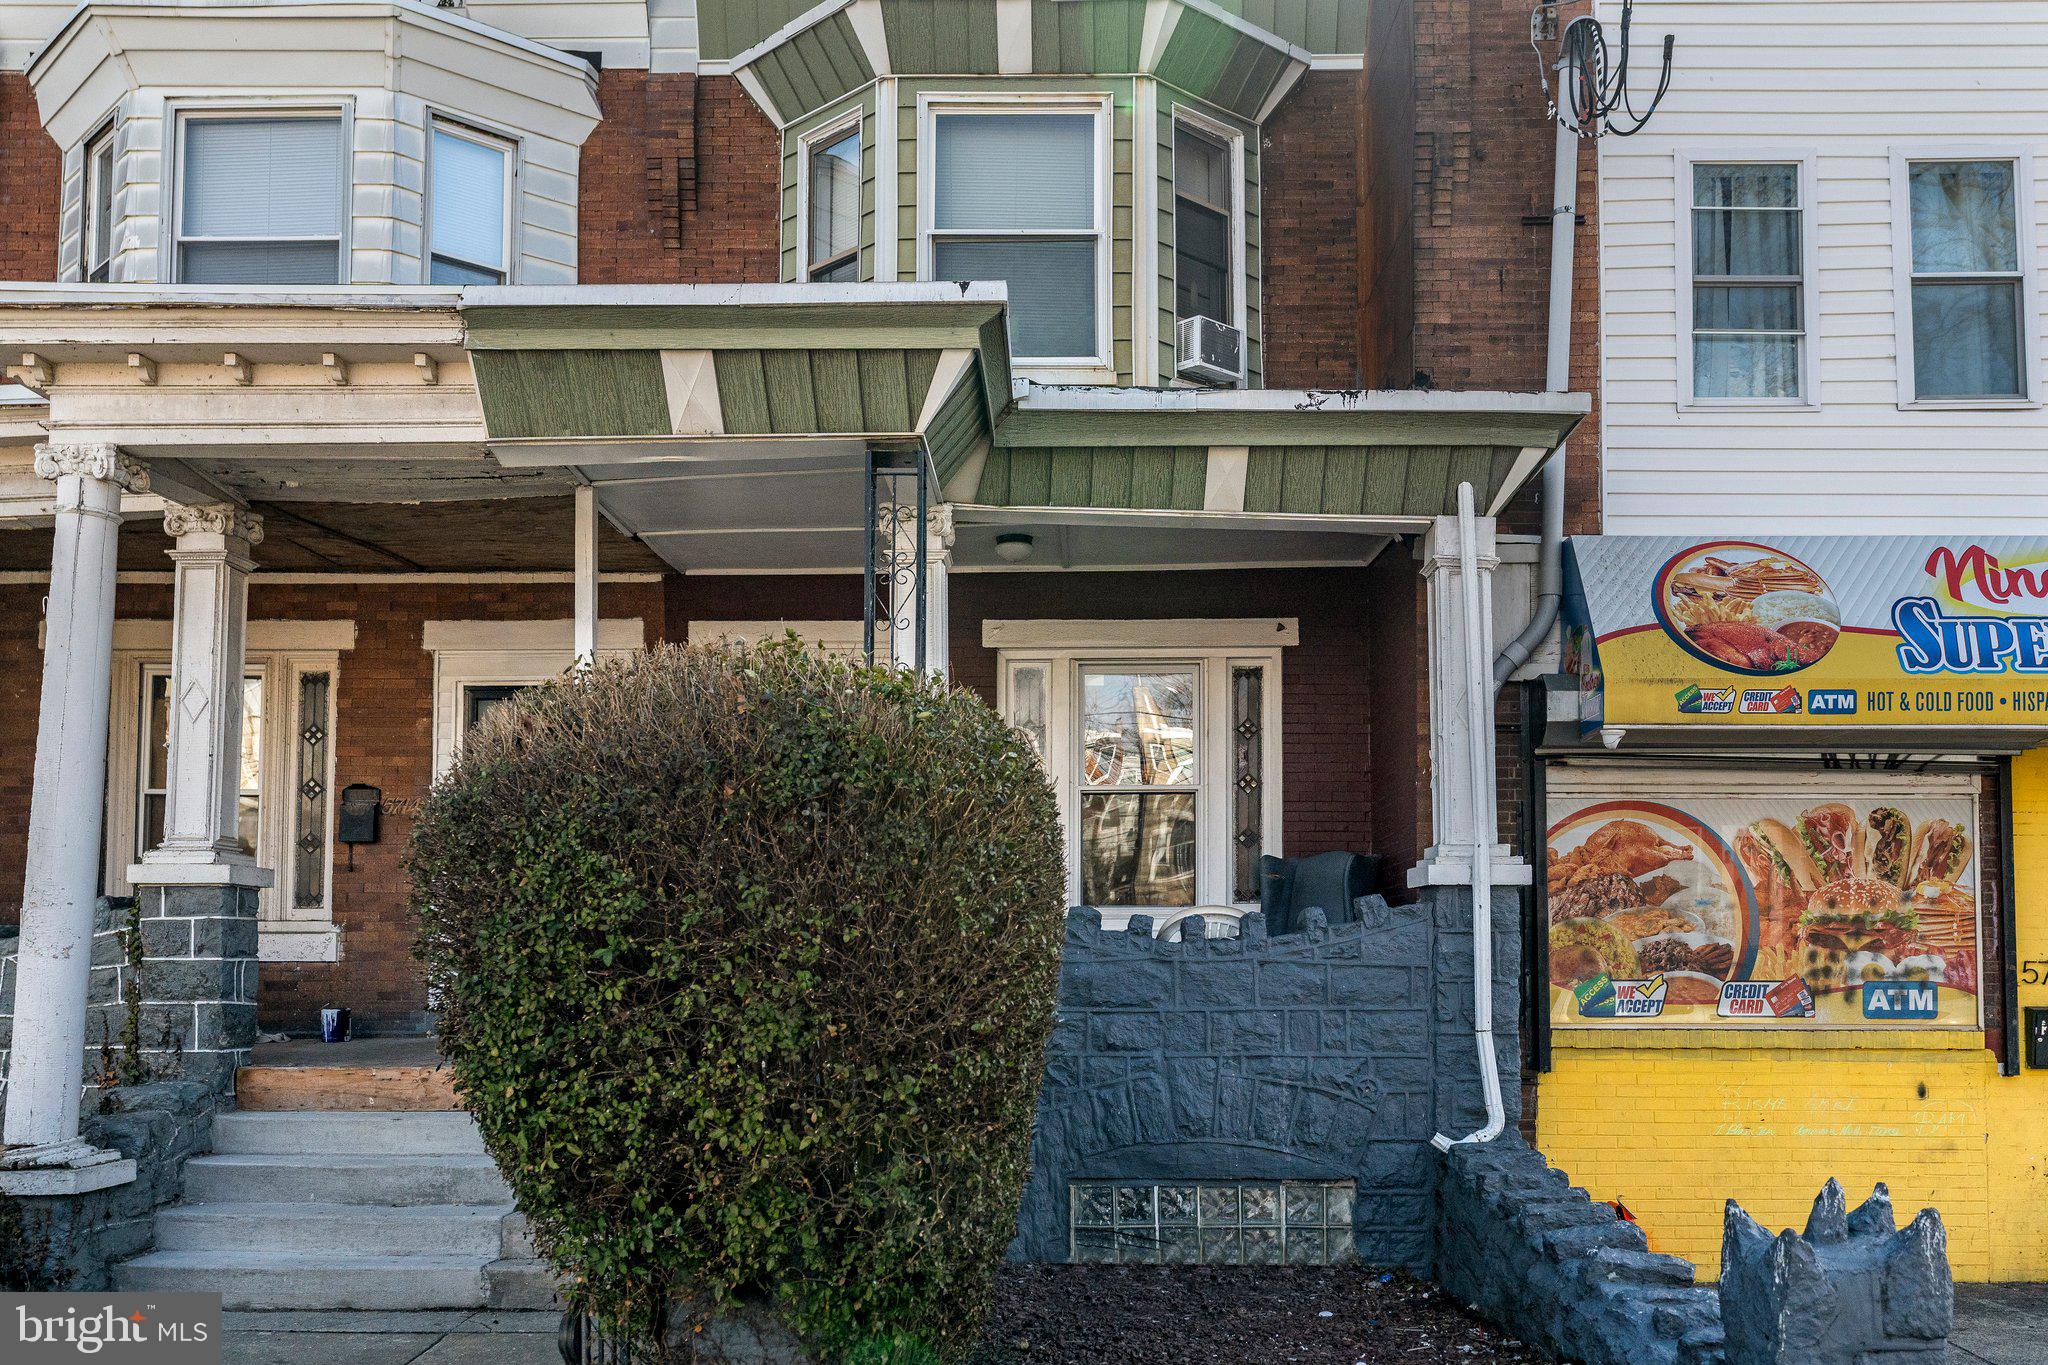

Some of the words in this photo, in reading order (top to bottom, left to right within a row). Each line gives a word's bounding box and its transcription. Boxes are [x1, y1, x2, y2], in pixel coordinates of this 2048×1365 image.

[1924, 544, 2048, 605] Nin
[1894, 598, 2048, 672] SUPE
[1702, 692, 1717, 702] WE
[1743, 691, 1774, 702] CREDIT
[1811, 694, 1854, 709] ATM
[1867, 691, 1895, 712] HOT
[1900, 691, 1911, 712] &
[1916, 691, 1951, 712] COLD
[1957, 691, 1994, 712] FOOD
[1702, 701, 1733, 711] ACCEPT
[1746, 701, 1770, 712] CARD
[1617, 985, 1636, 999] WE
[1724, 983, 1770, 999] CREDIT
[1616, 999, 1663, 1013] ACCEPT
[1729, 999, 1764, 1014] CARD
[1867, 989, 1934, 1011] ATM
